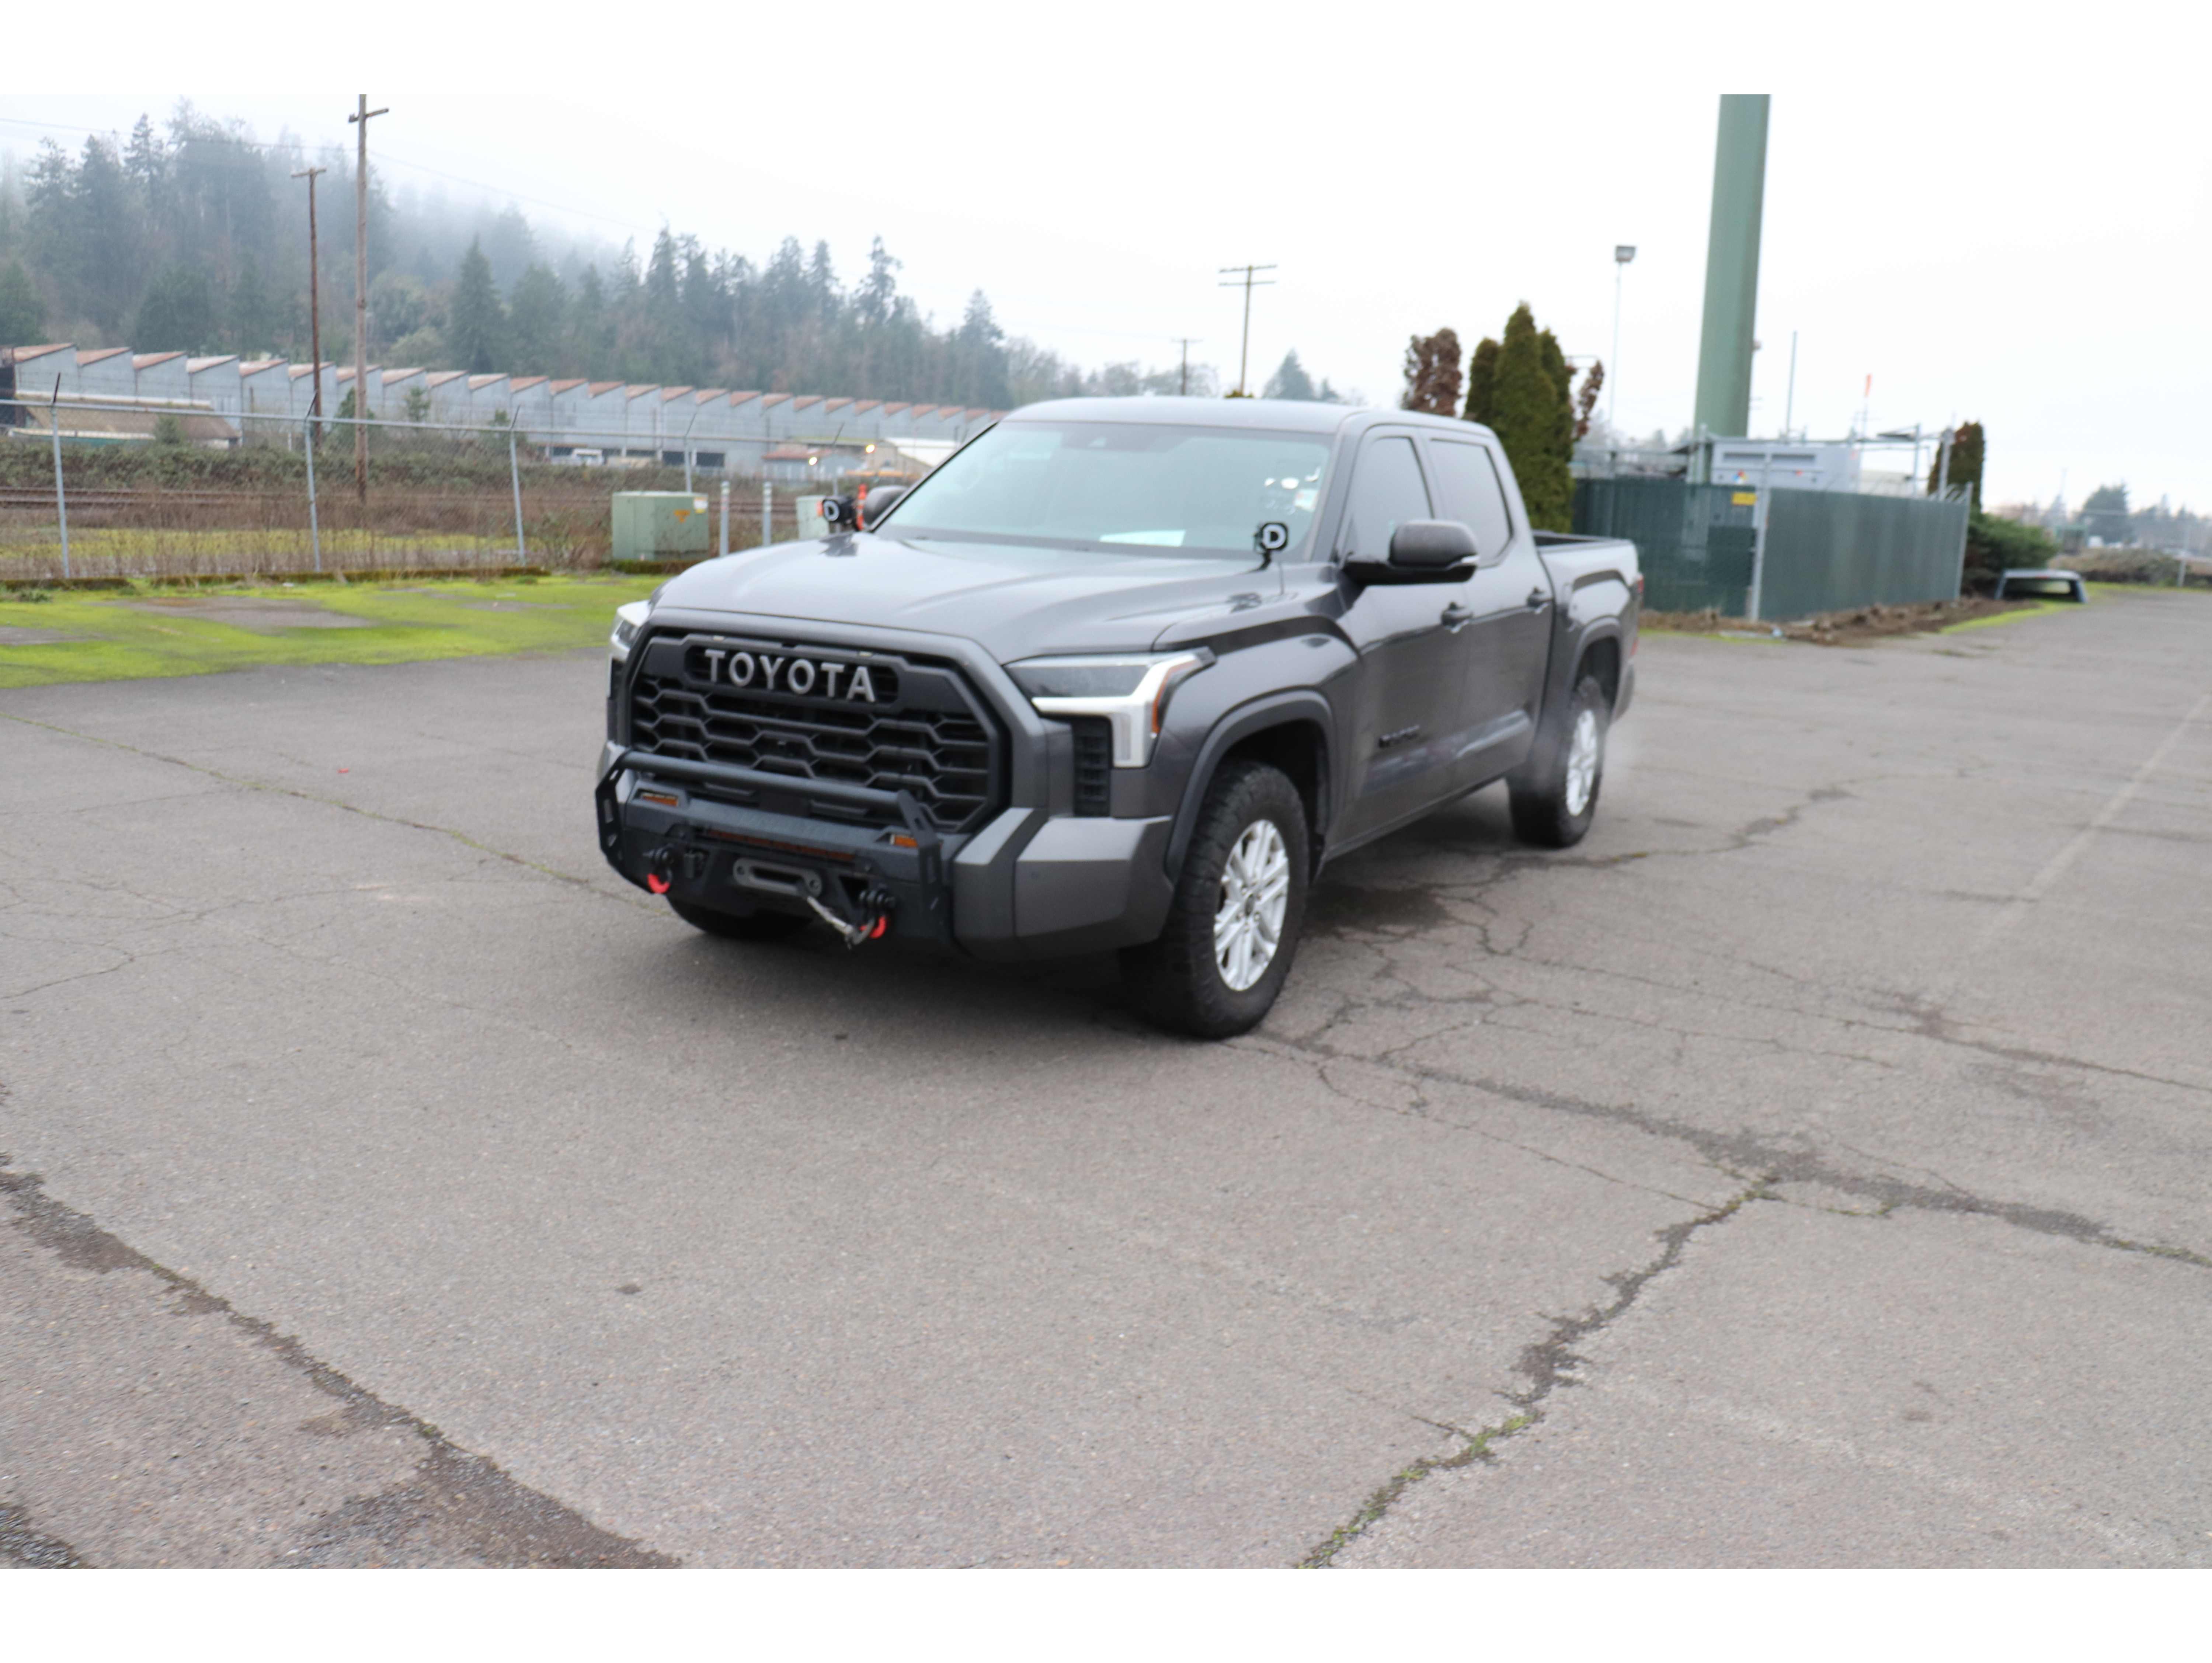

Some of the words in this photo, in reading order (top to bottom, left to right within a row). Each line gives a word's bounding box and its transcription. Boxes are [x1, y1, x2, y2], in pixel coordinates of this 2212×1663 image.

[824, 500, 839, 521] D
[1262, 524, 1286, 549] D
[705, 649, 876, 702] TOYOTA
